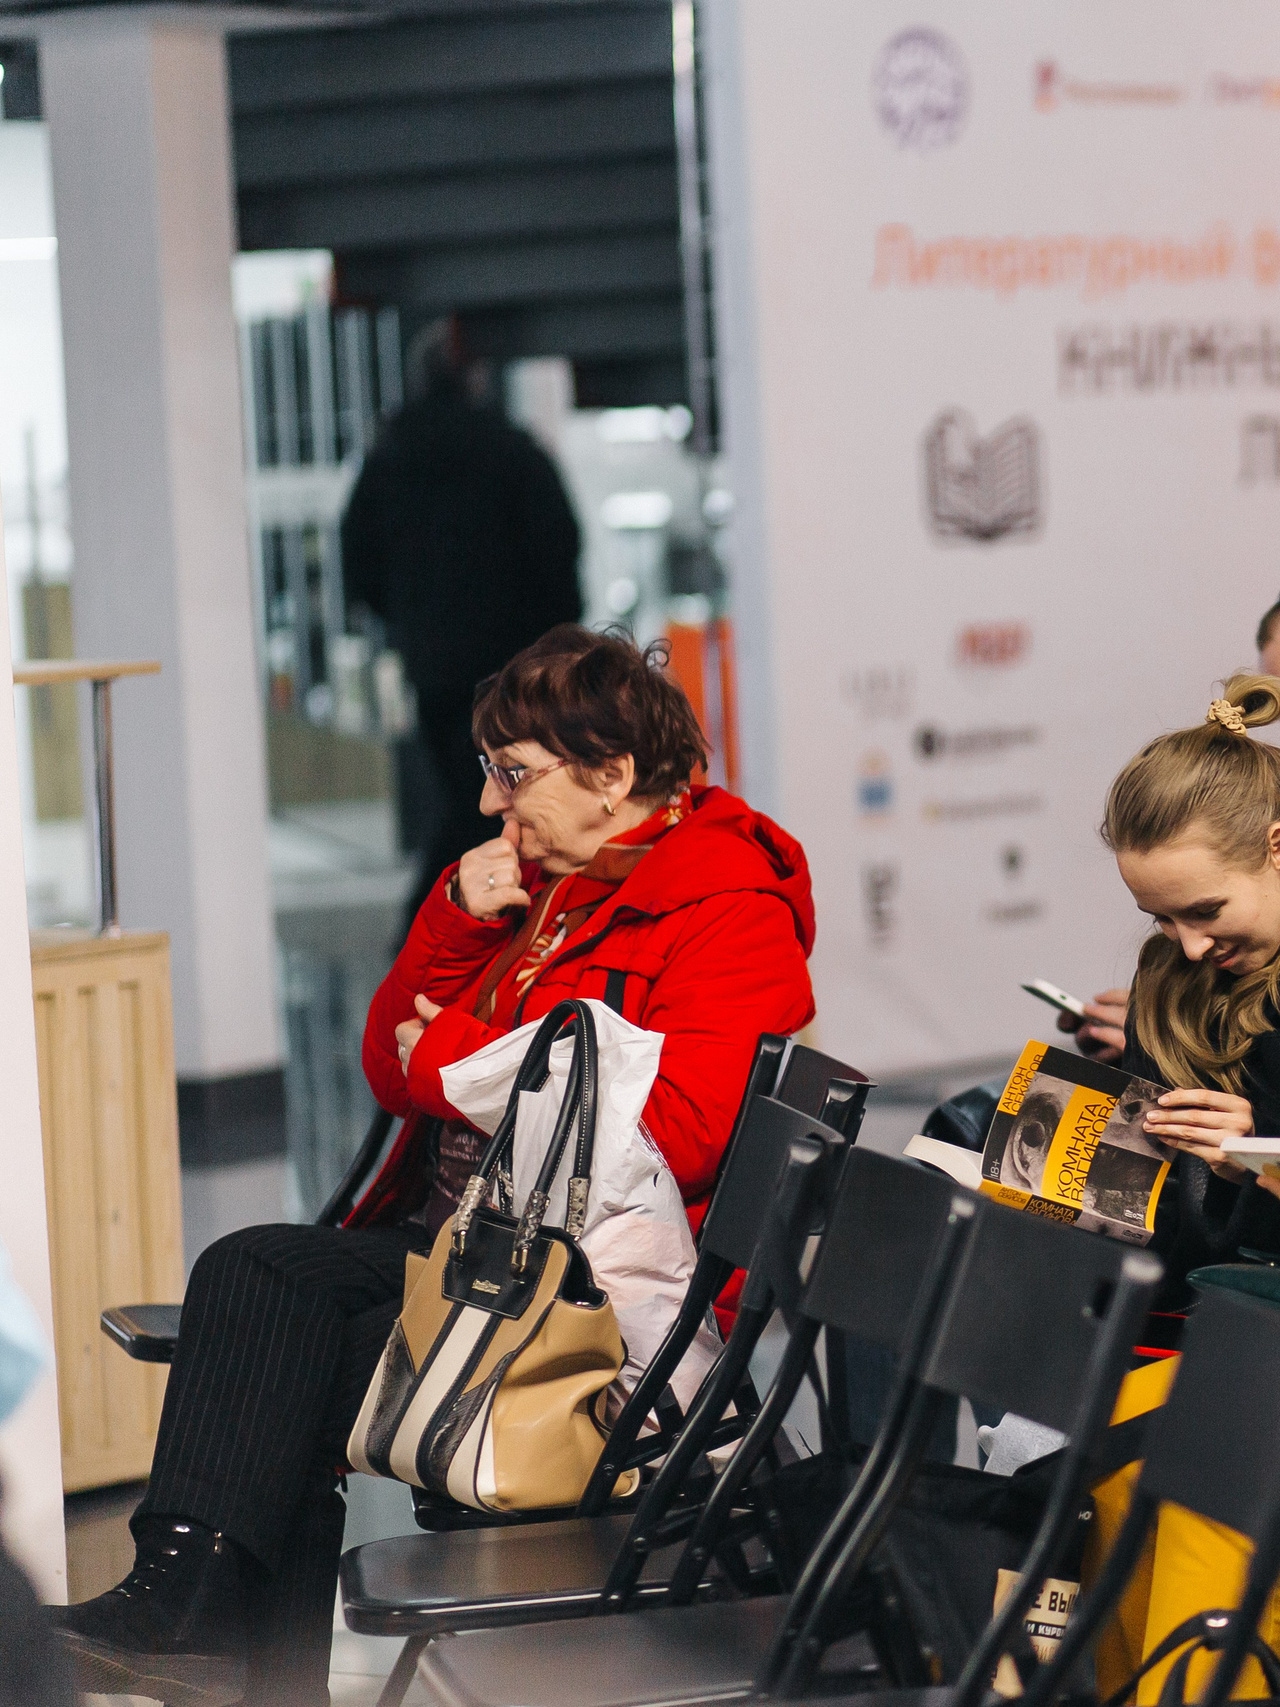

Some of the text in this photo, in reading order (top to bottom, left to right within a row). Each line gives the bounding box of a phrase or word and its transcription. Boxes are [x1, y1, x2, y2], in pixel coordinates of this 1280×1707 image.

[1002, 1066, 1028, 1110] АНТОН
[1011, 1054, 1044, 1113] СЕКИСОВ
[990, 1158, 1001, 1178] 18+
[1056, 1103, 1101, 1199] КОМНАТА
[1071, 1096, 1120, 1202] ВАГИНОВА
[1029, 1198, 1075, 1218] КОМНАТА
